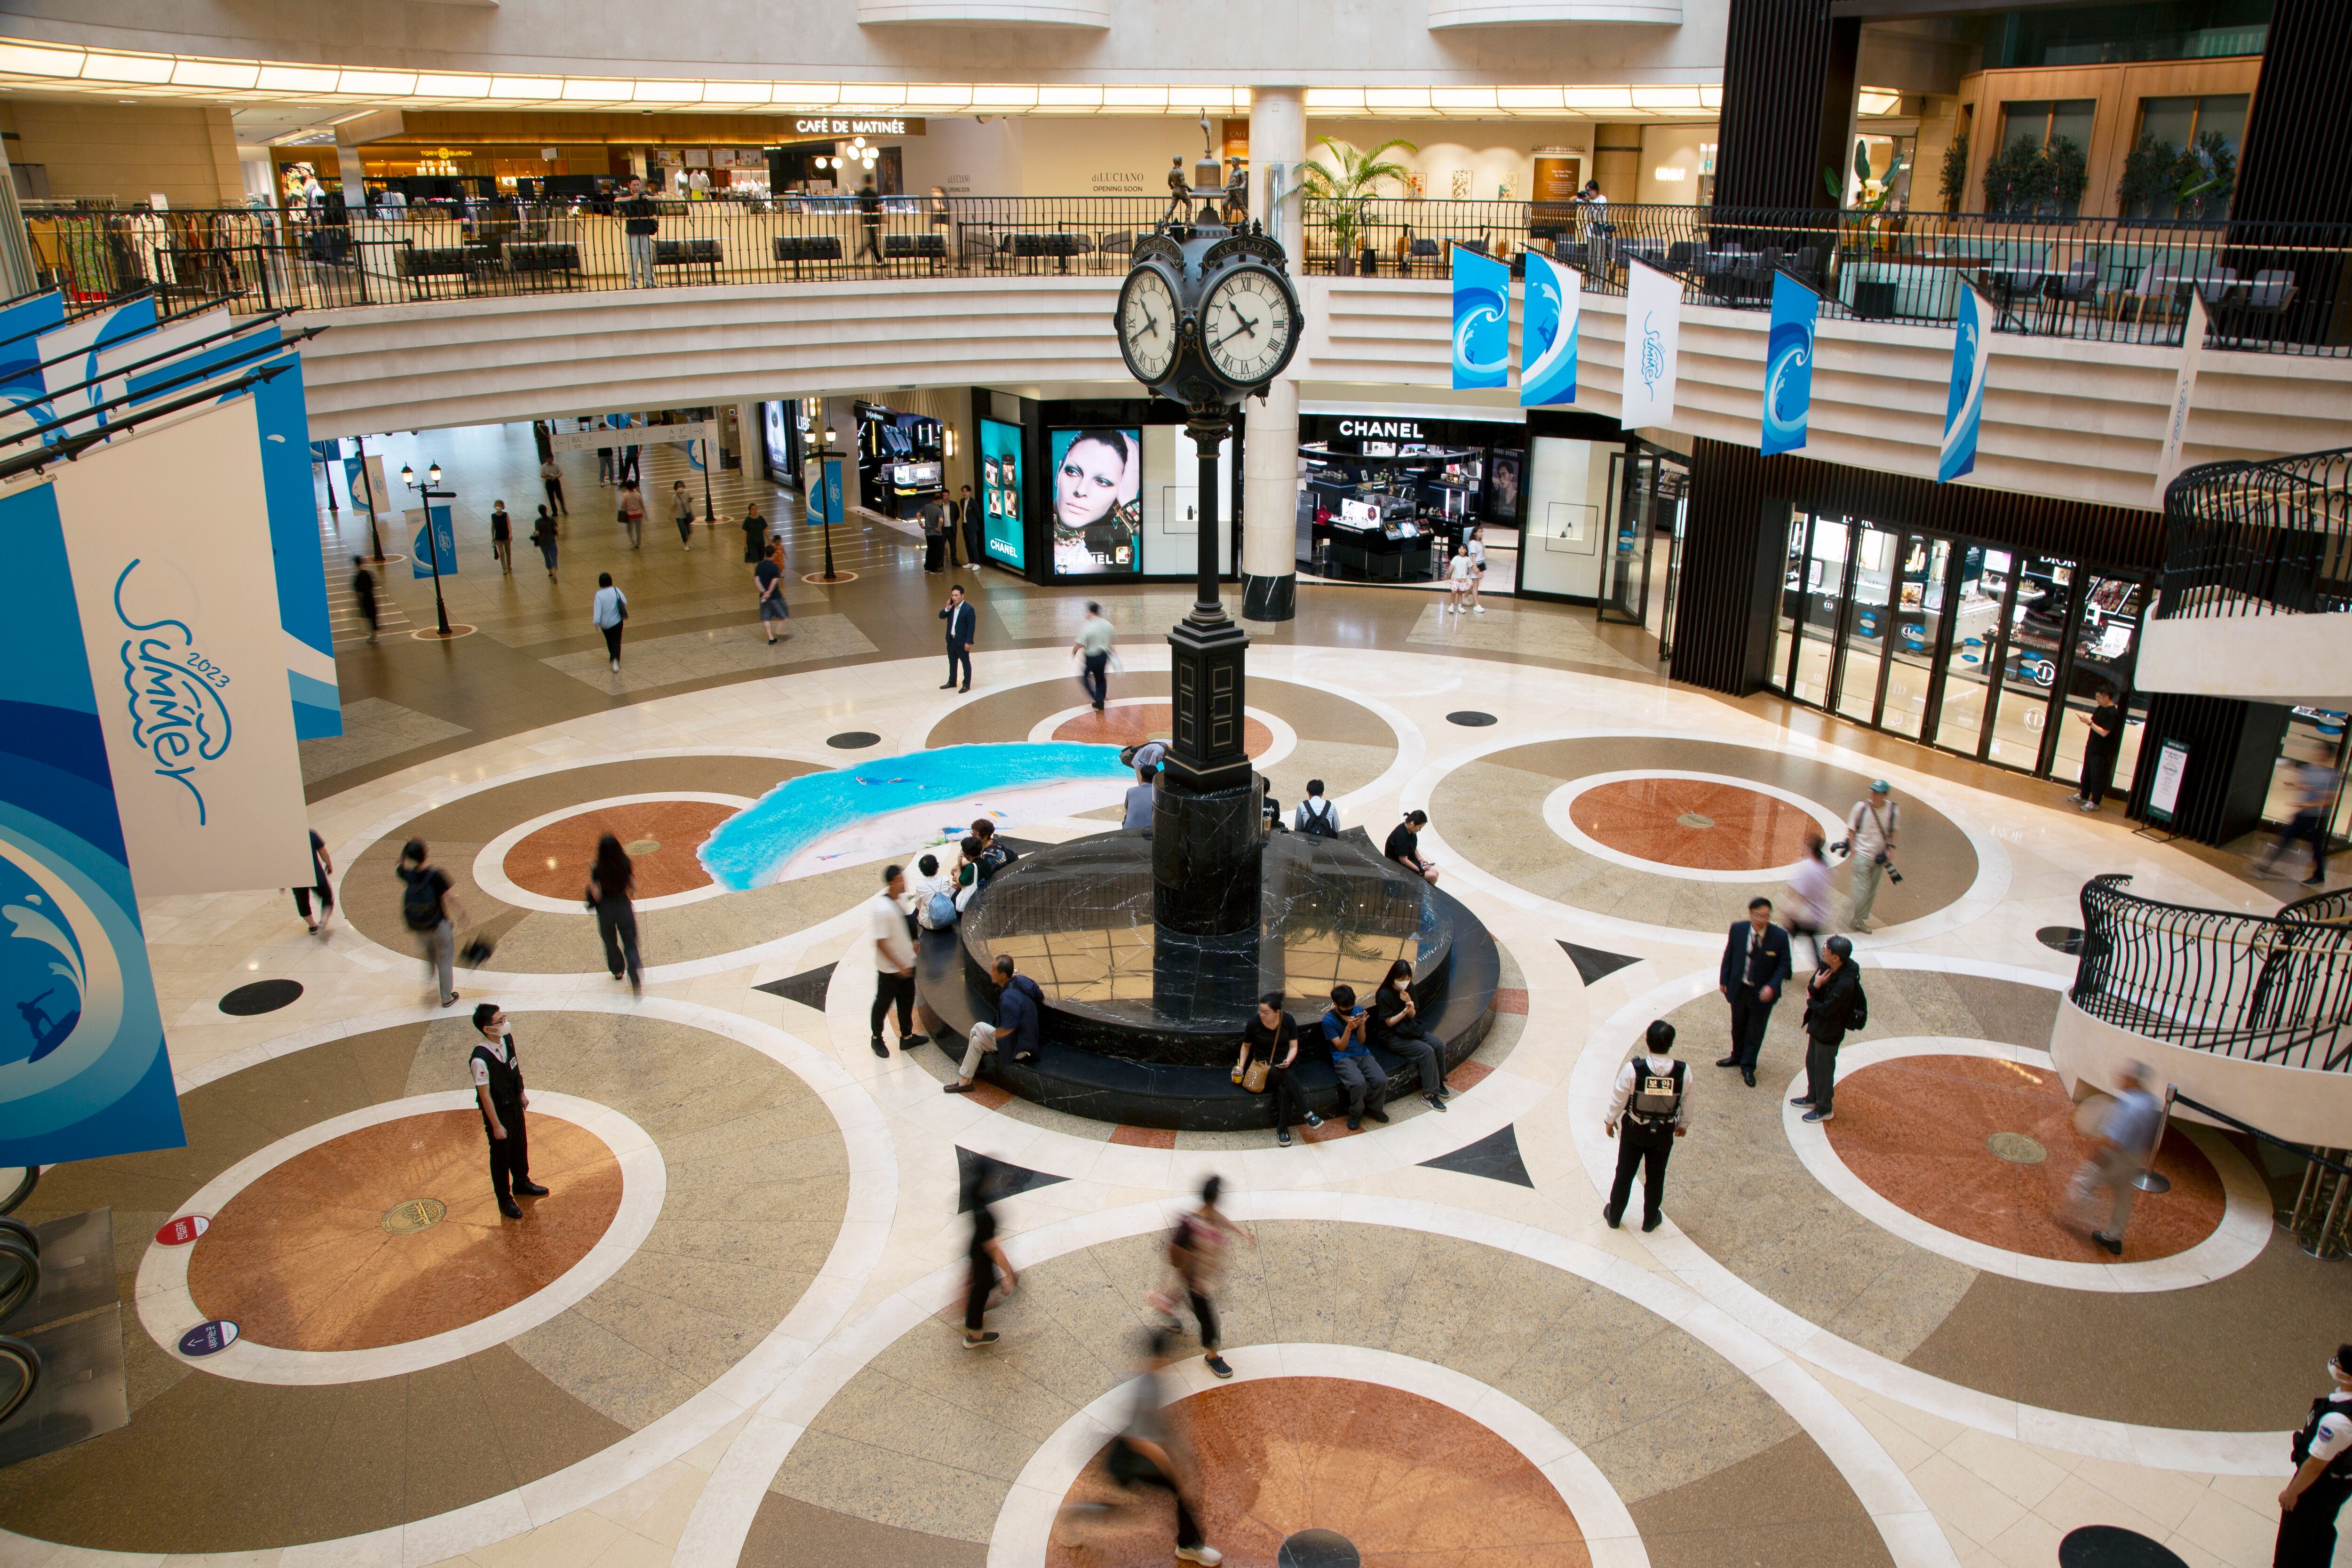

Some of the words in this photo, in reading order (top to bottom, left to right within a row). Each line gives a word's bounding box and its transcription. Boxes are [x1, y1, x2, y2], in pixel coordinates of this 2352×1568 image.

[796, 118, 828, 133] CAFÉ
[833, 121, 849, 133] DE
[852, 119, 905, 134] MATINÉE
[1092, 173, 1144, 182] diLUCIANO
[1140, 243, 1151, 255] AK
[1153, 240, 1174, 255] PLAZA
[1218, 244, 1232, 257] AK
[1237, 241, 1268, 255] PLAZA
[1340, 421, 1423, 438] CHANEL
[990, 539, 1009, 558] CHANEL
[187, 652, 230, 689] 2023
[175, 1221, 188, 1241] 진입금지
[206, 1325, 218, 1349] 내려가는곳
